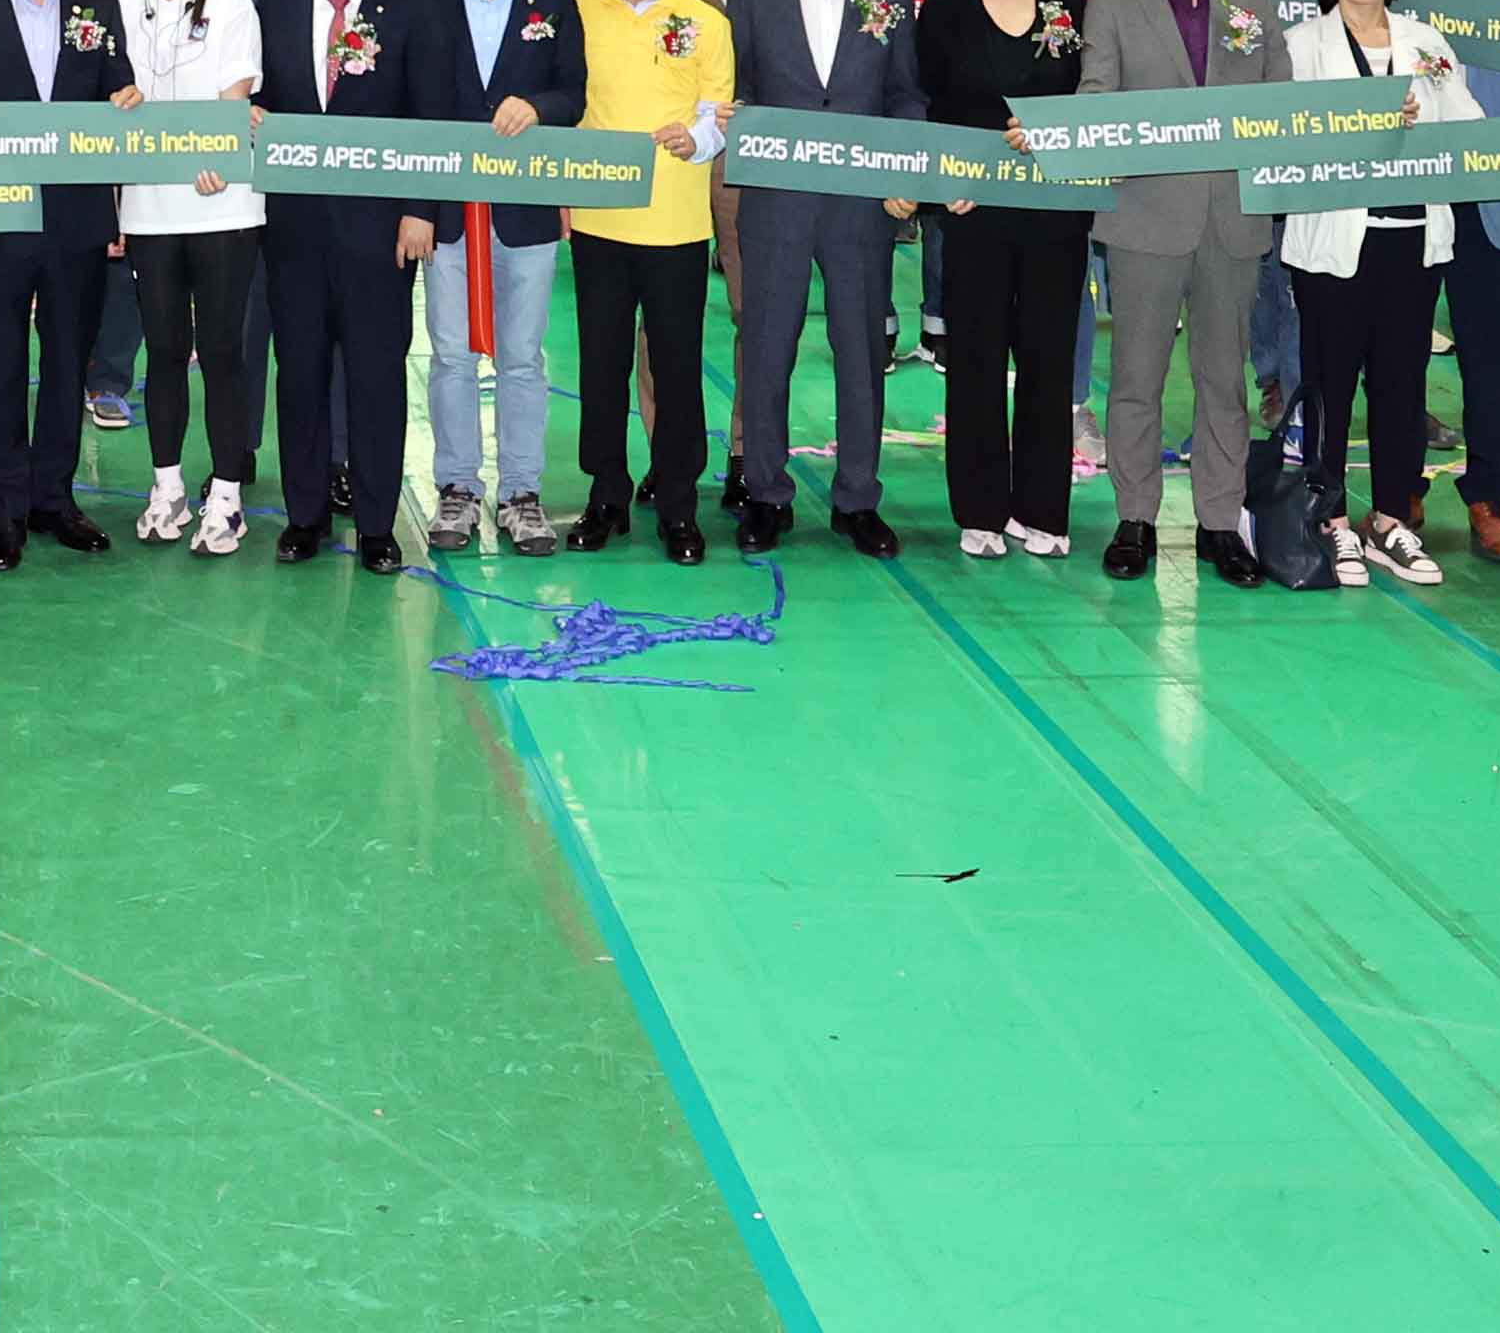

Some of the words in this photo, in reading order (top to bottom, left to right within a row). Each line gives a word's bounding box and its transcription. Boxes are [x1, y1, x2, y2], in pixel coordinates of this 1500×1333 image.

[126, 128, 155, 153] it's
[160, 130, 239, 153] Incheon
[1019, 126, 1071, 151] 2025
[1077, 123, 1132, 150] APEC
[1138, 118, 1221, 143] Summit
[1292, 110, 1323, 135] it's
[266, 143, 318, 168] 2025
[322, 145, 377, 170] APEC
[381, 147, 462, 174] Summit
[528, 152, 558, 179] it's
[563, 156, 642, 182] Incheon
[738, 135, 788, 161] 2025
[793, 139, 845, 166] APEC
[850, 144, 929, 173] Summit
[997, 158, 1027, 182] it's
[1371, 155, 1454, 181] Summit
